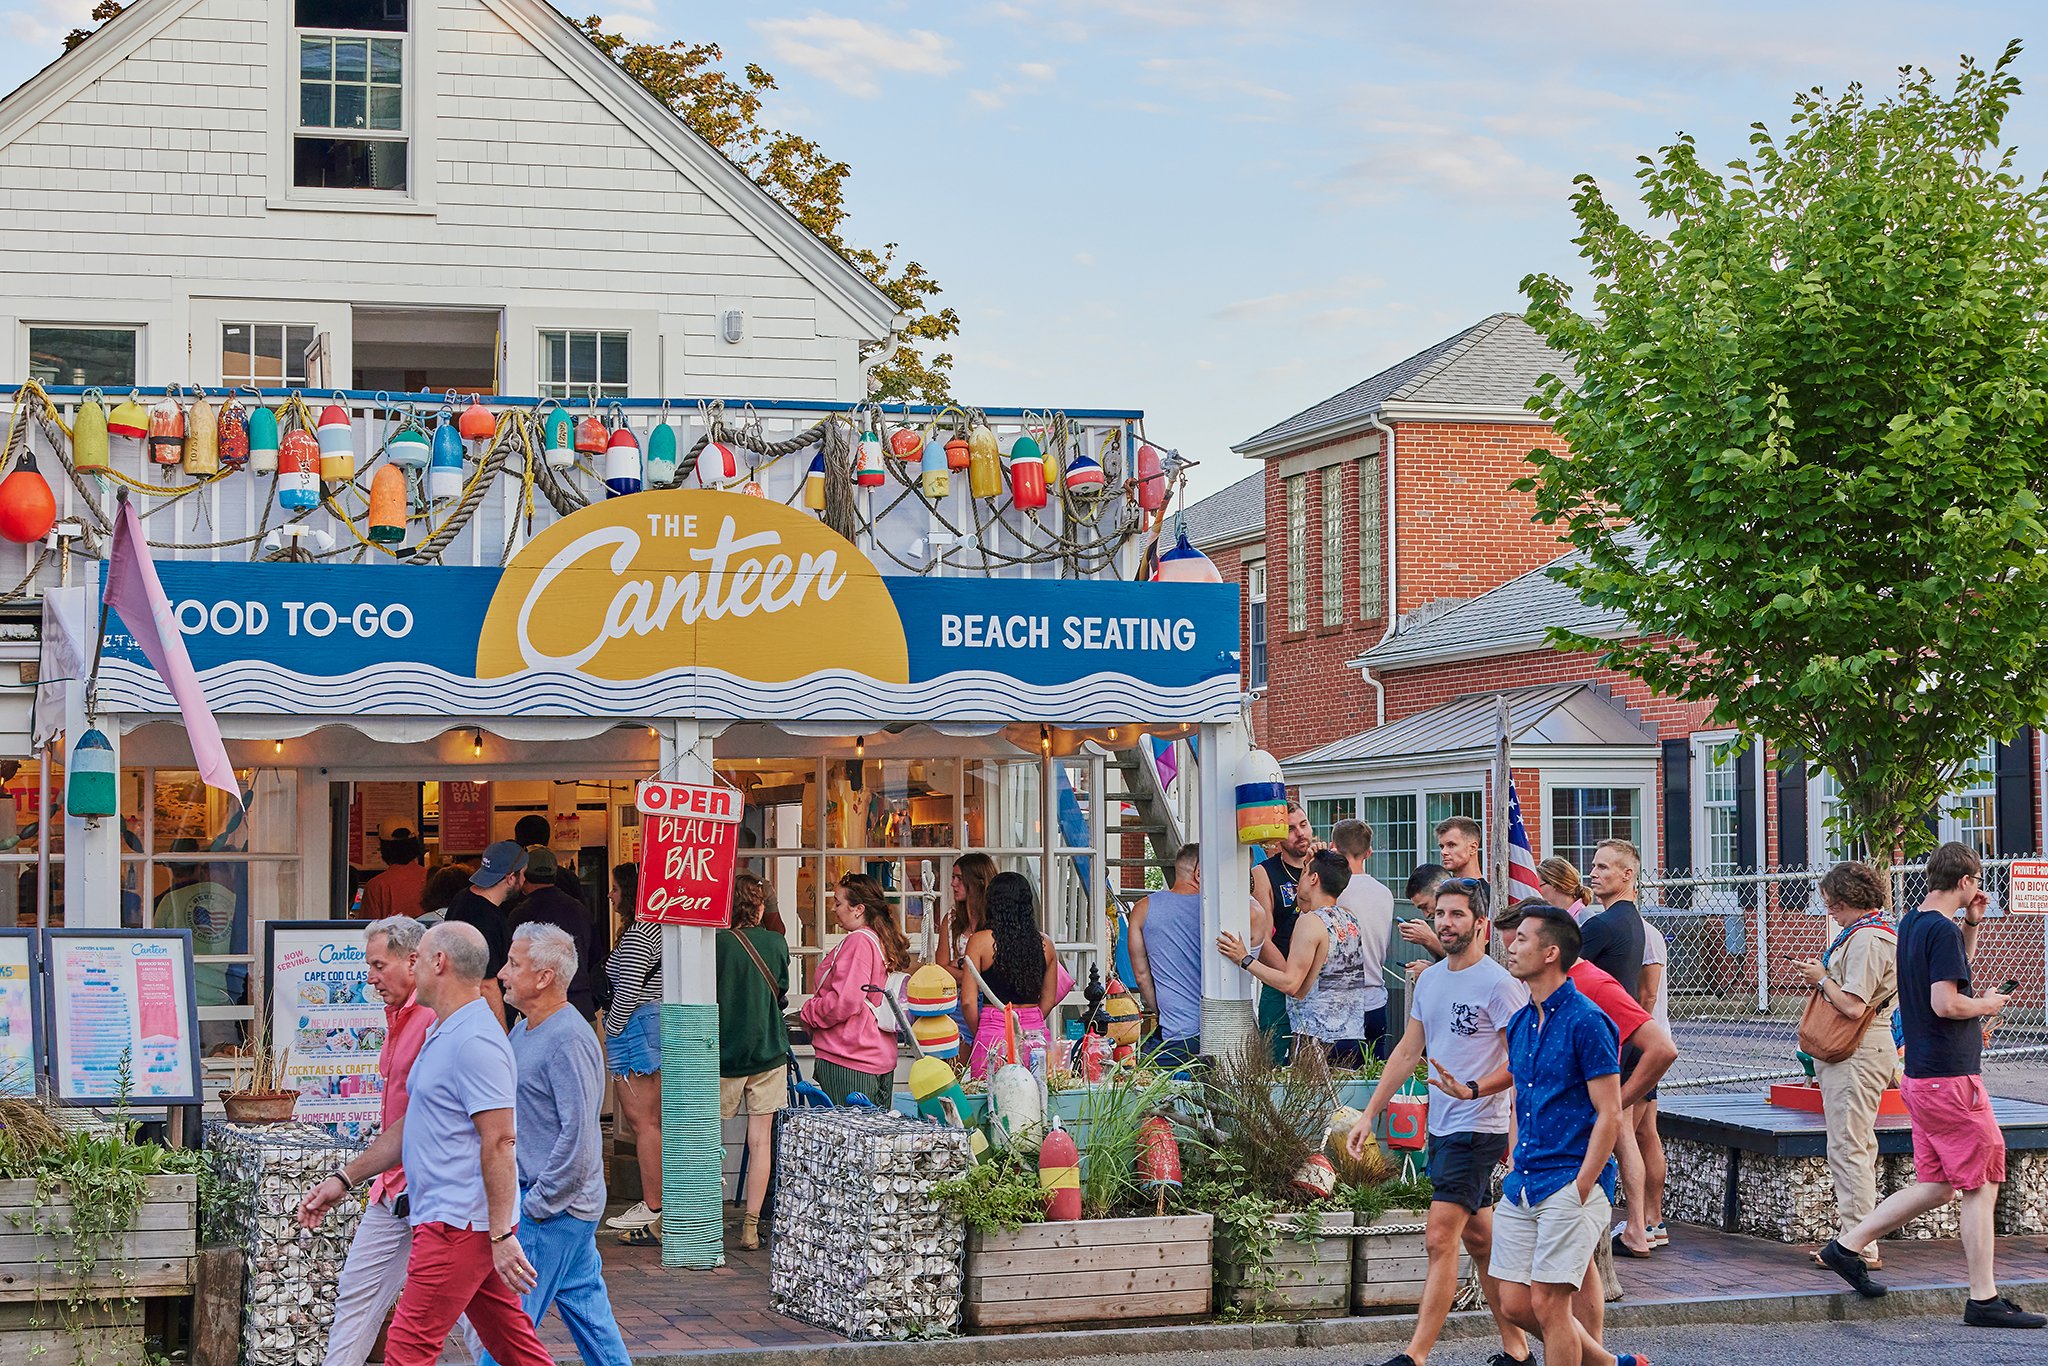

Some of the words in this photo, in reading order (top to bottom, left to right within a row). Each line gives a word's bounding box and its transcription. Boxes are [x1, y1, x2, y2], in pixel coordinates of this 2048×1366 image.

[647, 513, 698, 538] THE
[517, 514, 847, 670] Canteen
[167, 599, 269, 636] OOD
[282, 601, 414, 639] TO-GO
[941, 613, 1050, 649] BEACH
[1062, 615, 1196, 652] SEATING
[451, 782, 482, 793] RAW
[453, 793, 480, 803] BAR
[643, 785, 731, 816] OPEN
[657, 816, 725, 845] BEACH
[664, 845, 719, 882] BAR
[2013, 865, 2037, 875] PRIVATE
[677, 885, 686, 893] is
[2014, 881, 2026, 891] NO
[646, 886, 712, 921] Open
[131, 942, 168, 956] Canteen
[284, 949, 304, 962] NOW
[276, 956, 317, 972] SERVING...
[304, 971, 326, 982] CAPE
[327, 971, 344, 981] COD
[310, 1018, 330, 1028] NEW
[332, 1017, 379, 1028] FAVORITES
[288, 1065, 334, 1076] COCKTAILS
[336, 1065, 343, 1075] &
[345, 1064, 373, 1074] CRAFT
[301, 1112, 348, 1123] HOMEMADE
